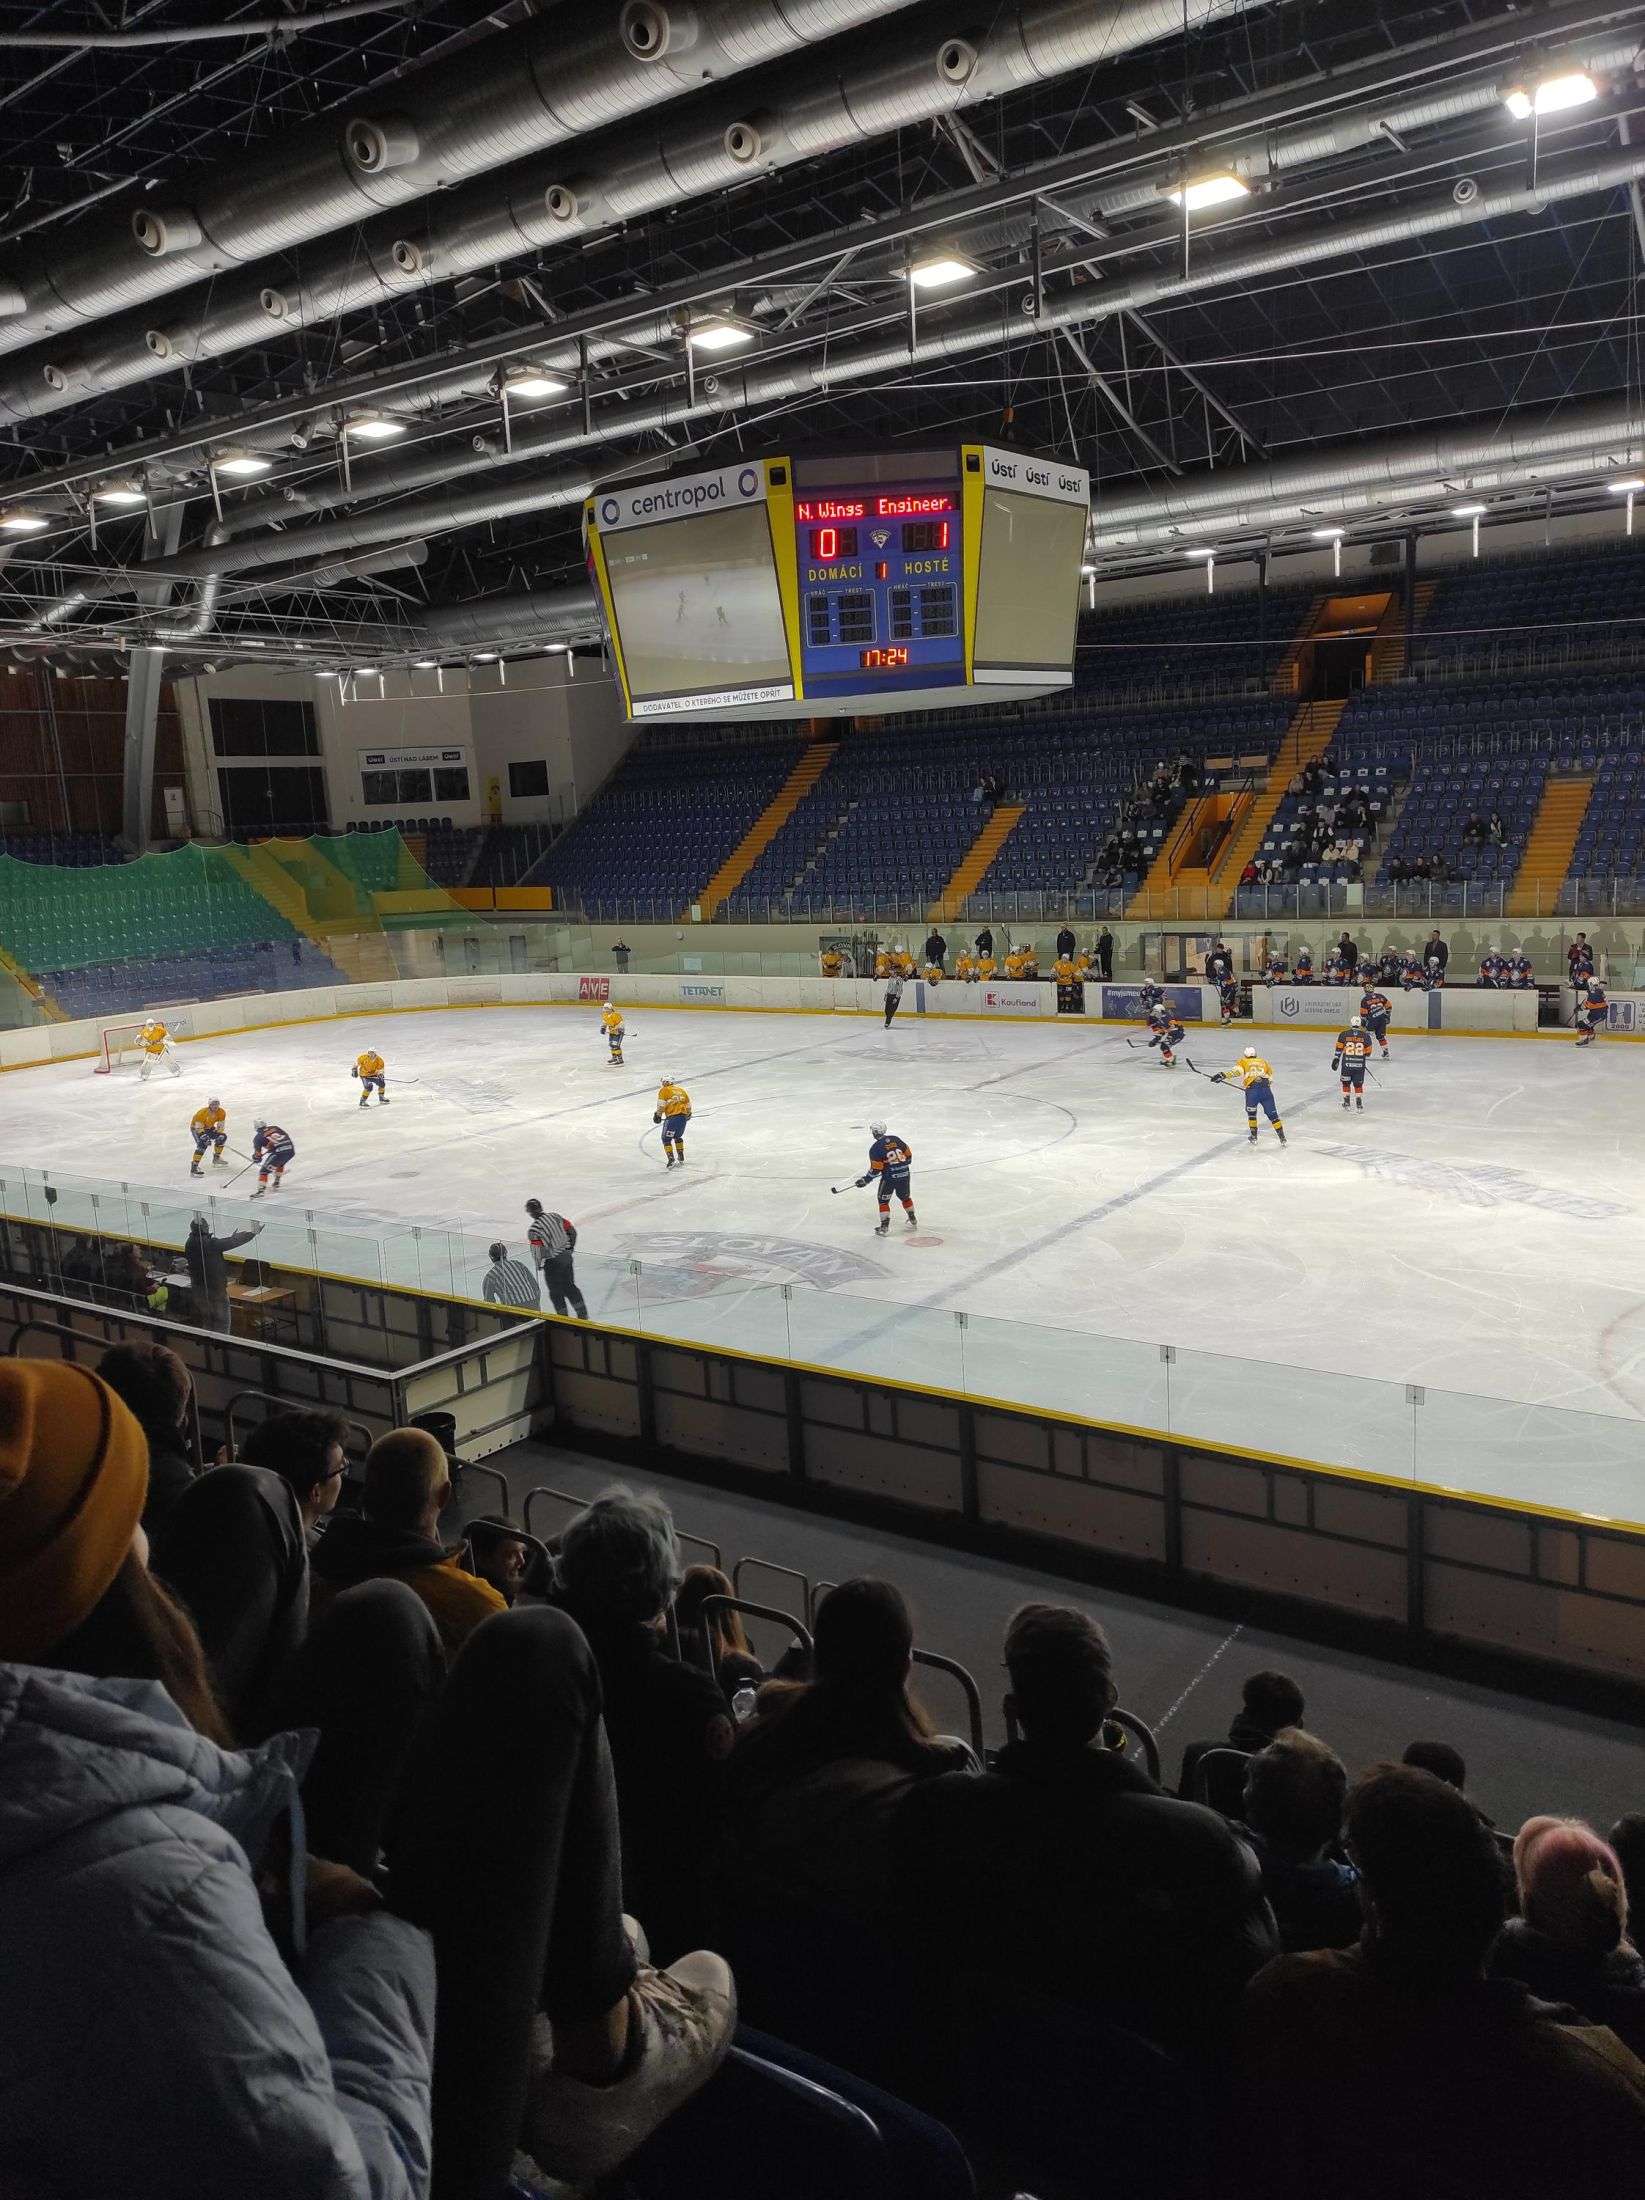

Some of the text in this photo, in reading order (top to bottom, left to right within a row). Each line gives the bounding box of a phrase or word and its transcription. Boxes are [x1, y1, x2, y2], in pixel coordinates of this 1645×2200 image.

[992, 459, 1082, 493] Ústí Ústí Ústí
[631, 476, 726, 516] centropol
[798, 502, 864, 520] N. Wings
[820, 528, 836, 557] 0
[808, 562, 863, 582] DOMÁCÍ
[904, 556, 950, 575] HOSTÉ
[865, 647, 908, 667] 17:24
[579, 982, 609, 996] AVE
[1001, 998, 1037, 1008] Kaufland
